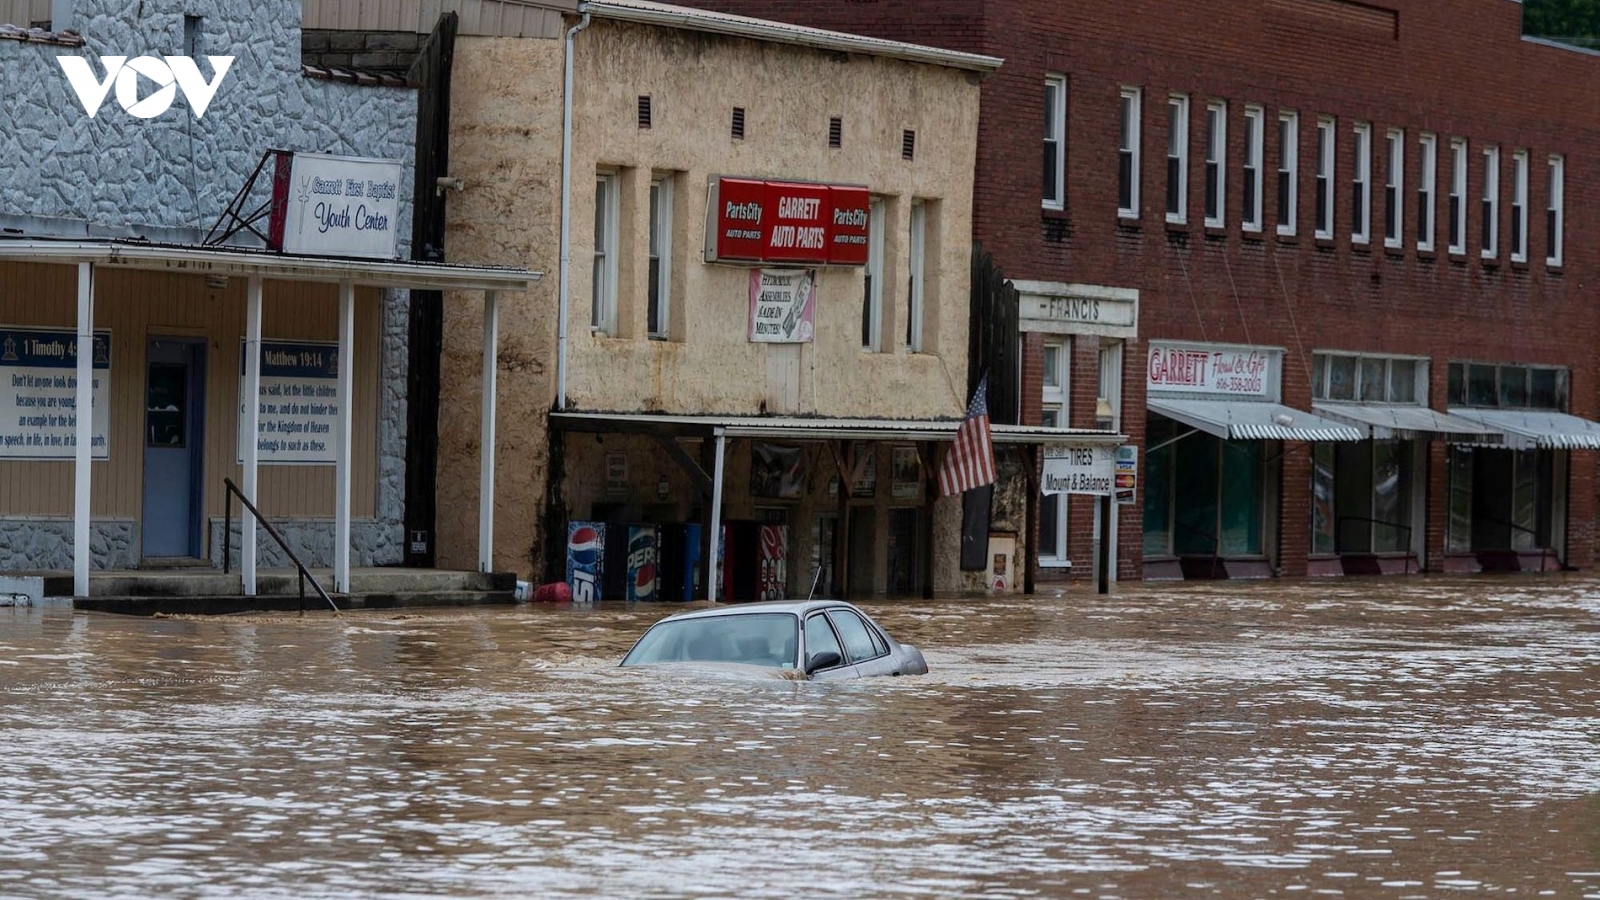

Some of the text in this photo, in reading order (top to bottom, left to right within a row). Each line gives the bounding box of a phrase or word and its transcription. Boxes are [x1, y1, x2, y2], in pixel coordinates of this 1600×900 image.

[312, 176, 396, 202] Garrett First Baptist
[779, 197, 821, 220] GARRETT
[314, 202, 388, 233] Youth Center
[726, 230, 762, 240] AUTO PARTS
[771, 226, 825, 249] AUTO PARTS
[834, 235, 867, 244] AUTO PARTS
[1049, 298, 1100, 321] FRANCIS
[24, 340, 77, 359] 1 Timothy 4:
[265, 351, 322, 367] Matthew 19:14
[1150, 347, 1209, 386] GARRETT
[54, 376, 65, 389] look
[293, 385, 301, 397] the
[316, 385, 337, 398] children
[16, 394, 37, 408] because
[37, 397, 47, 410] you
[47, 397, 57, 408] are
[280, 403, 290, 415] and
[292, 403, 299, 415] do
[301, 404, 309, 415] not
[311, 403, 328, 416] hinder
[27, 414, 48, 430] example
[49, 414, 57, 427] for
[59, 415, 67, 427] the
[267, 420, 276, 433] the
[278, 421, 302, 435] Kingdom
[304, 421, 310, 433] of
[311, 421, 330, 434] Heaven
[281, 440, 287, 451] to
[288, 440, 300, 452] such
[302, 442, 309, 452] as
[1070, 448, 1093, 466] TIRES
[1046, 474, 1070, 491] Mount
[1072, 473, 1078, 490] &
[1080, 473, 1110, 491] Balance
